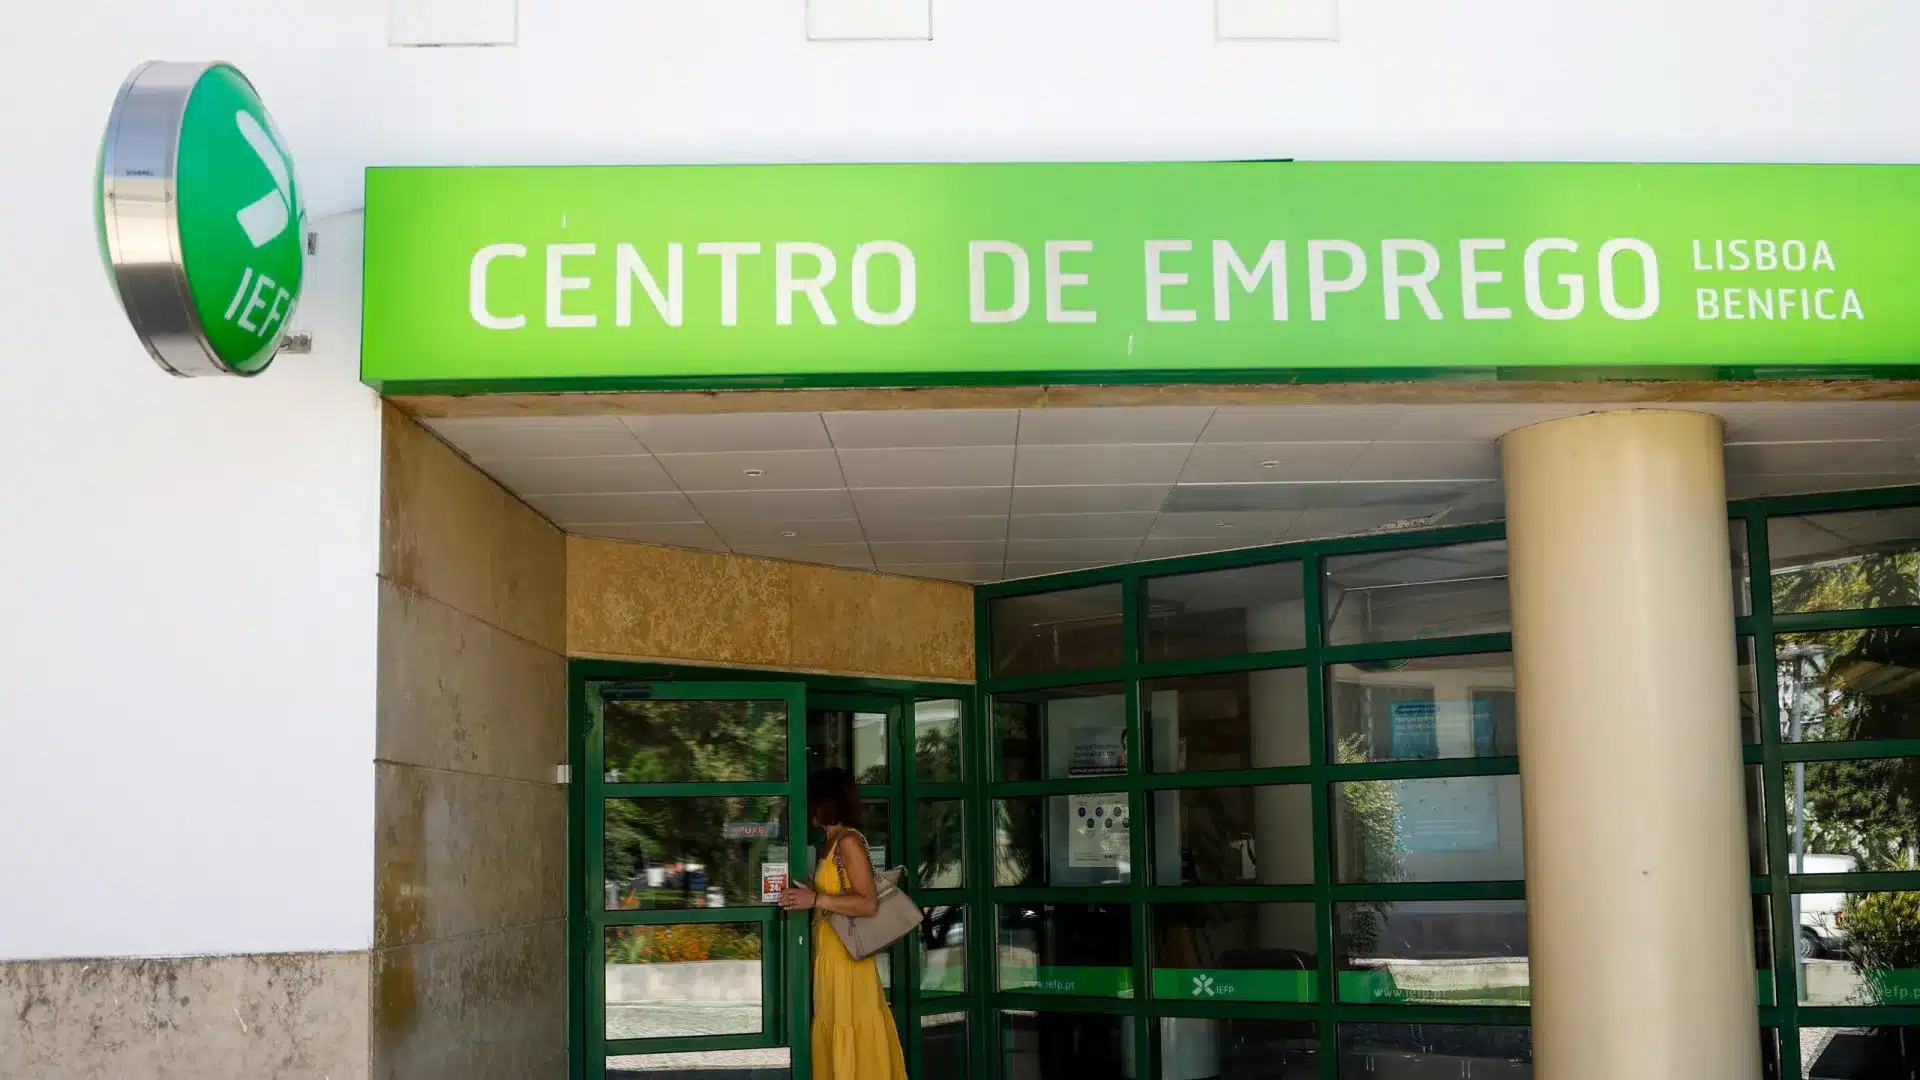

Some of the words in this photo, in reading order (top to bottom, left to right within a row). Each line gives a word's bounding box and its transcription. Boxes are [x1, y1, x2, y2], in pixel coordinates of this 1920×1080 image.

[1692, 239, 1836, 272] LISBOA
[469, 239, 918, 329] CENTRO
[967, 238, 1099, 325] DE
[1143, 236, 1661, 323] EMPREGO
[1695, 288, 1865, 321] BENFICA
[1023, 979, 1075, 991] www.iefp.pt
[1216, 985, 1235, 995] IEFP
